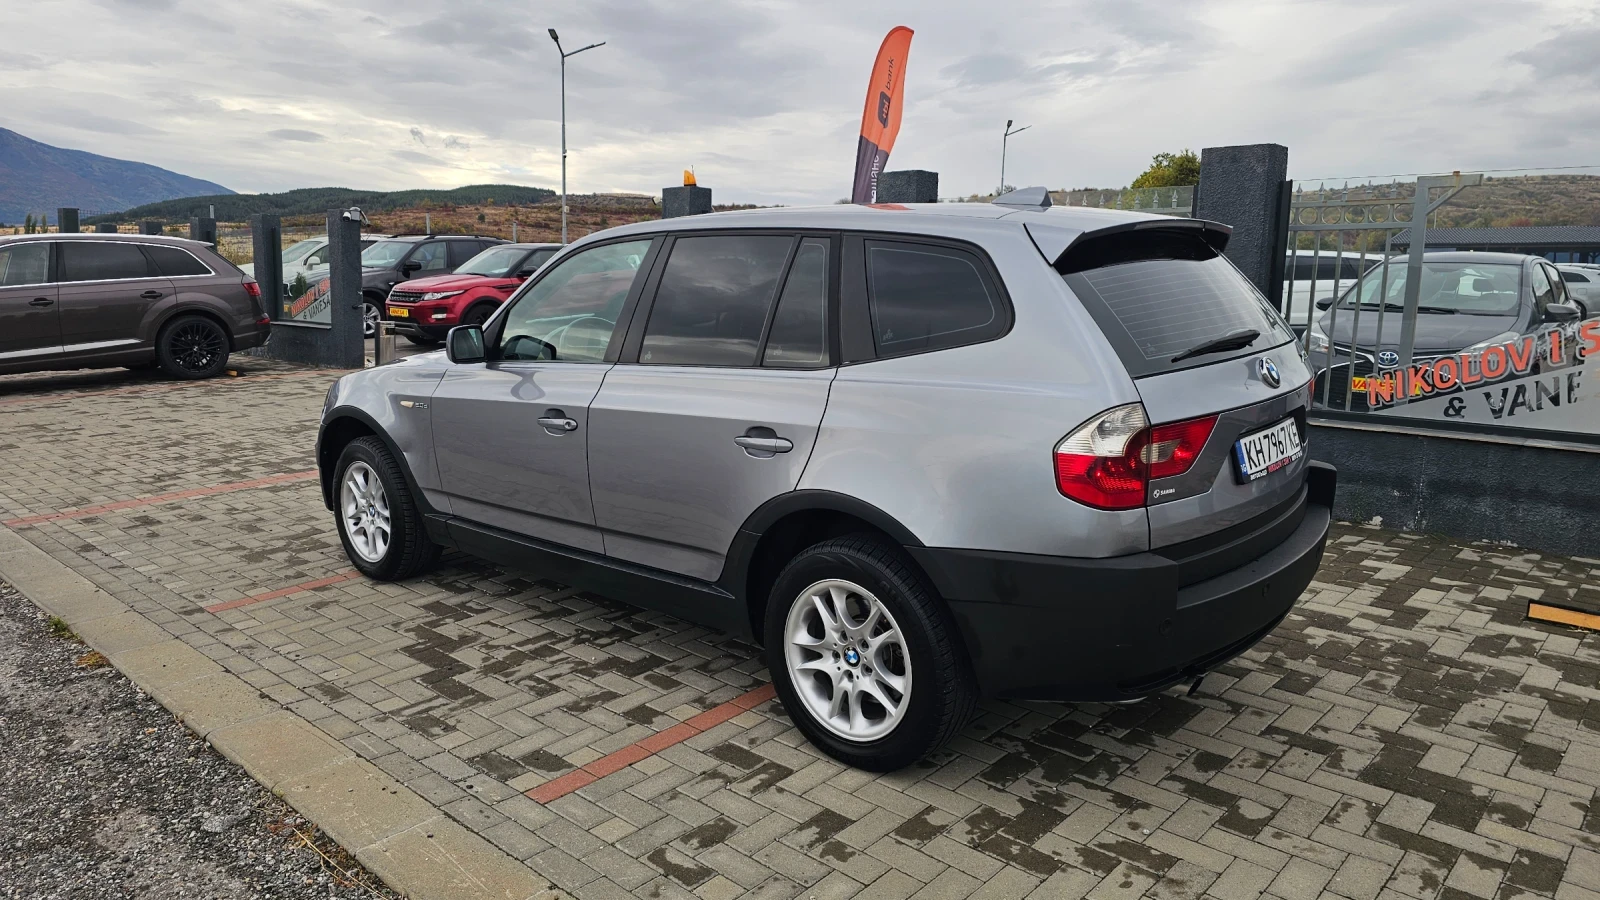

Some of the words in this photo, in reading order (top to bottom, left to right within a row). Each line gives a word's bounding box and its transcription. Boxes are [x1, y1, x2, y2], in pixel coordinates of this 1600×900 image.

[885, 56, 894, 91] bank
[308, 294, 331, 319] VANESA
[1367, 337, 1534, 406] NIKOLOV
[1550, 330, 1562, 364] I
[1443, 397, 1467, 419] &
[1244, 421, 1300, 470] KH7967KE
